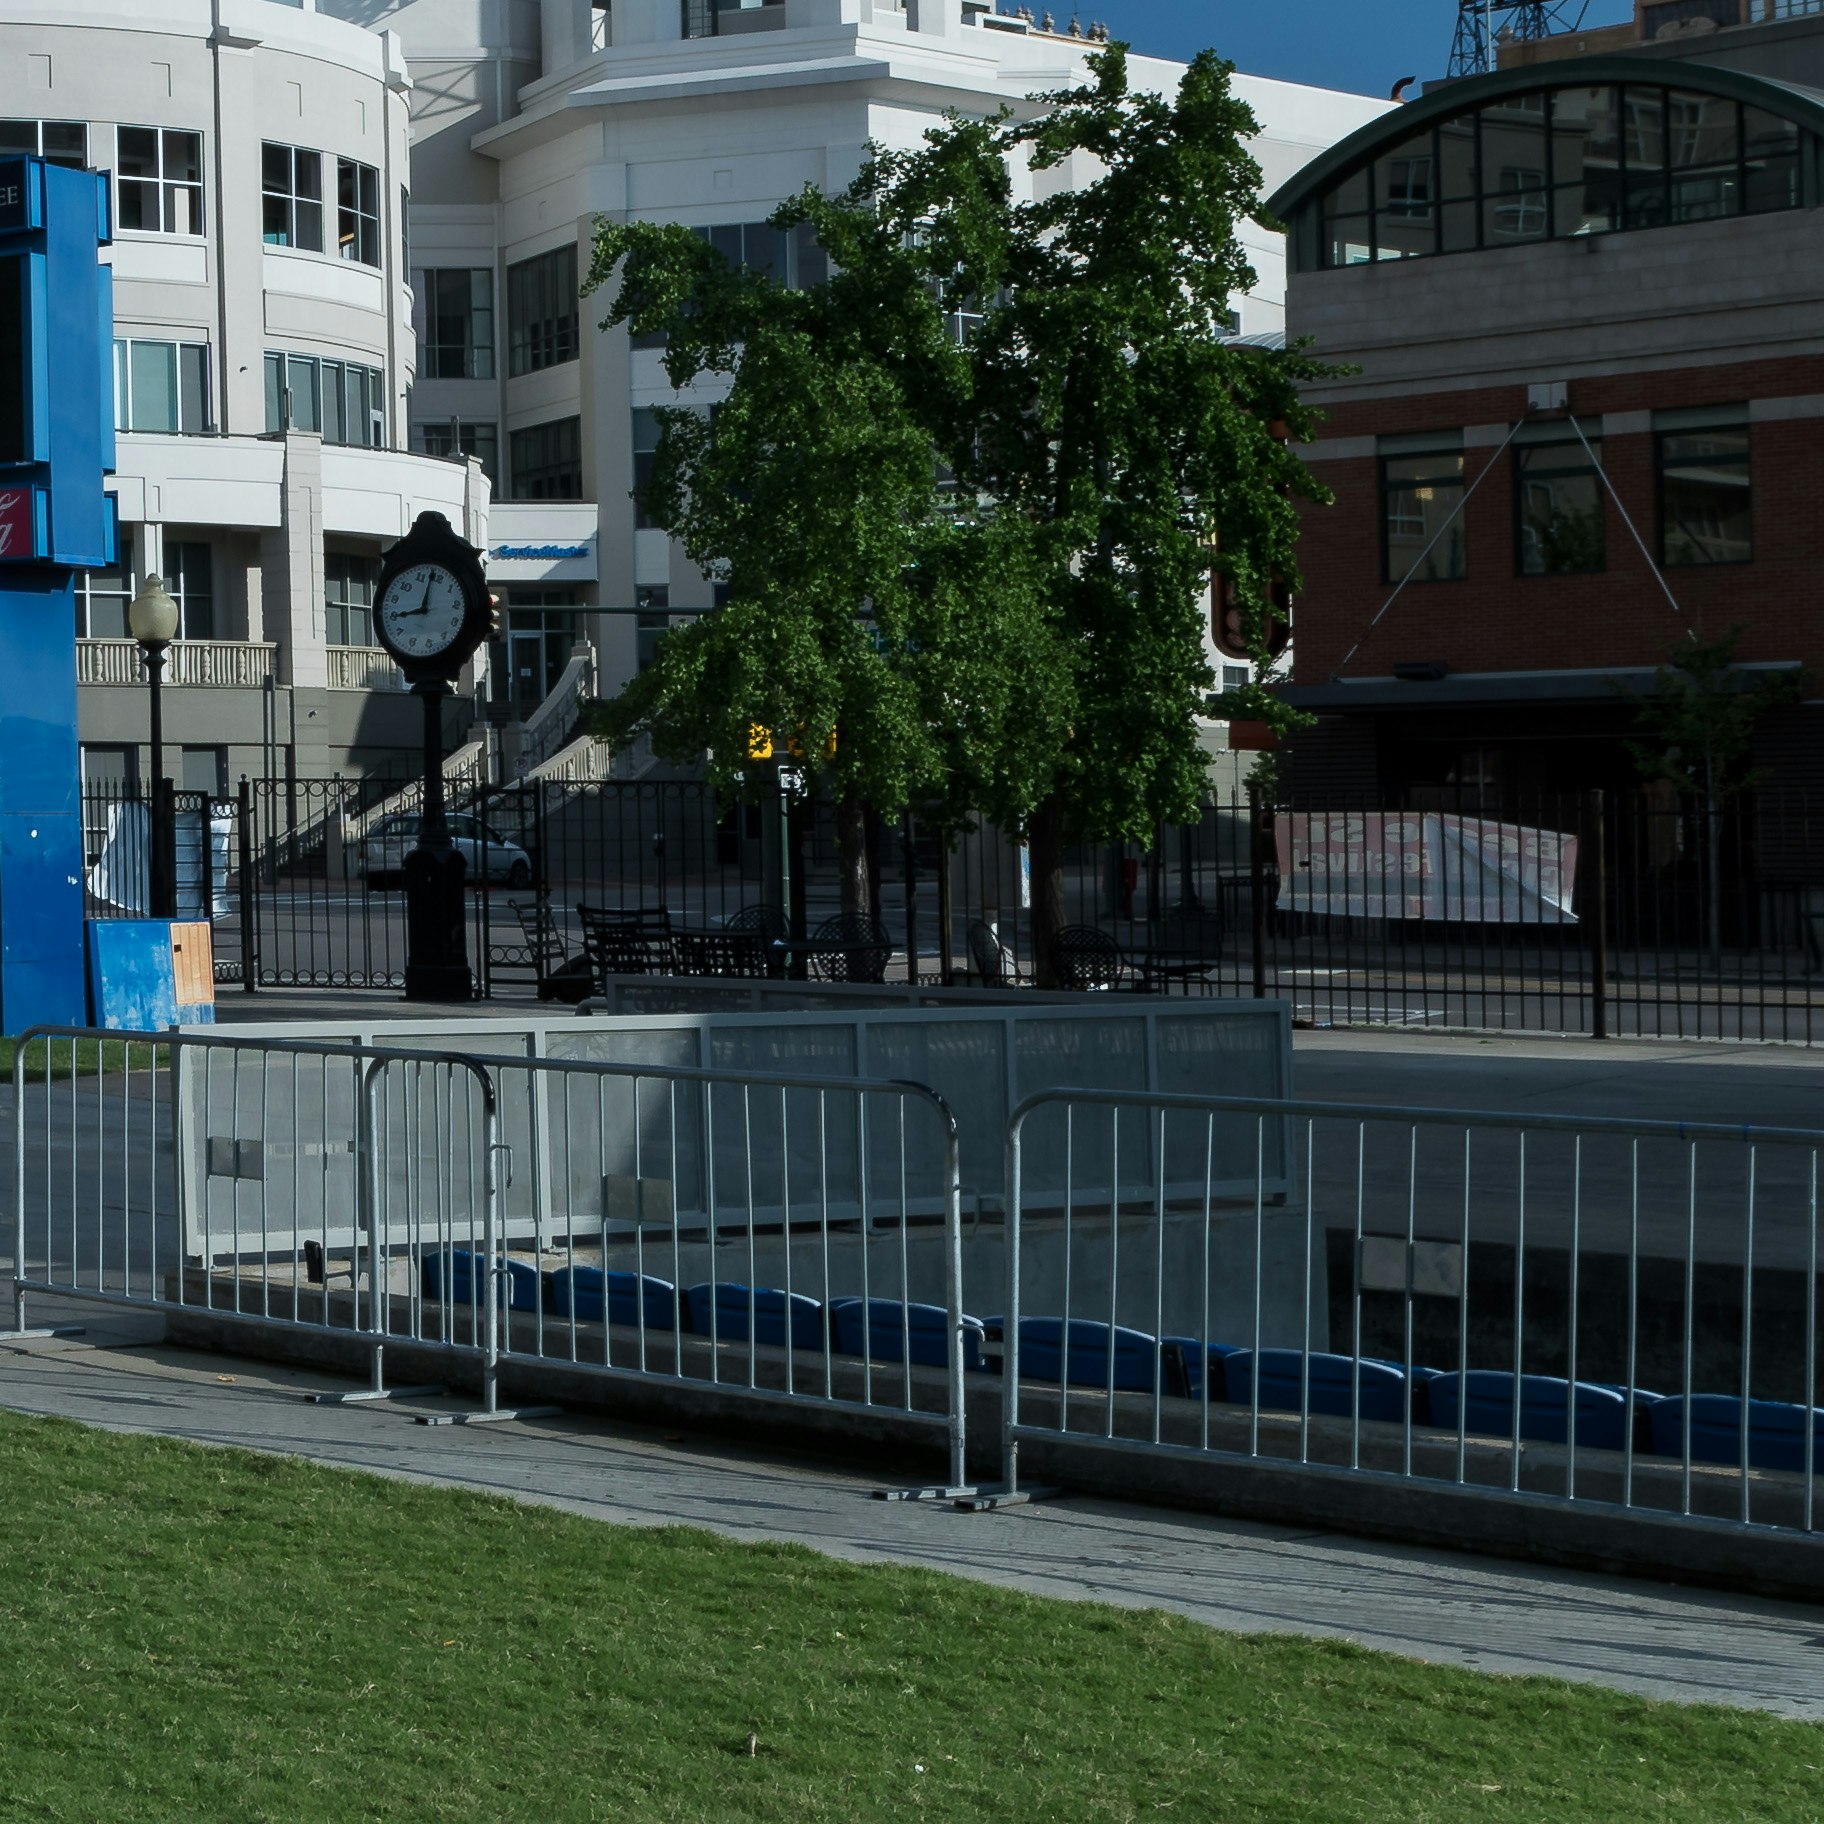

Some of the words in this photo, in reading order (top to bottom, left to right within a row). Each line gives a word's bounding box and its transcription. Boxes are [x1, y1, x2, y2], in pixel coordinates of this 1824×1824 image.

[415, 572, 426, 583] 11
[400, 581, 412, 592] 10
[452, 599, 460, 610] 2
[451, 616, 459, 627] 3
[396, 627, 404, 636] 7
